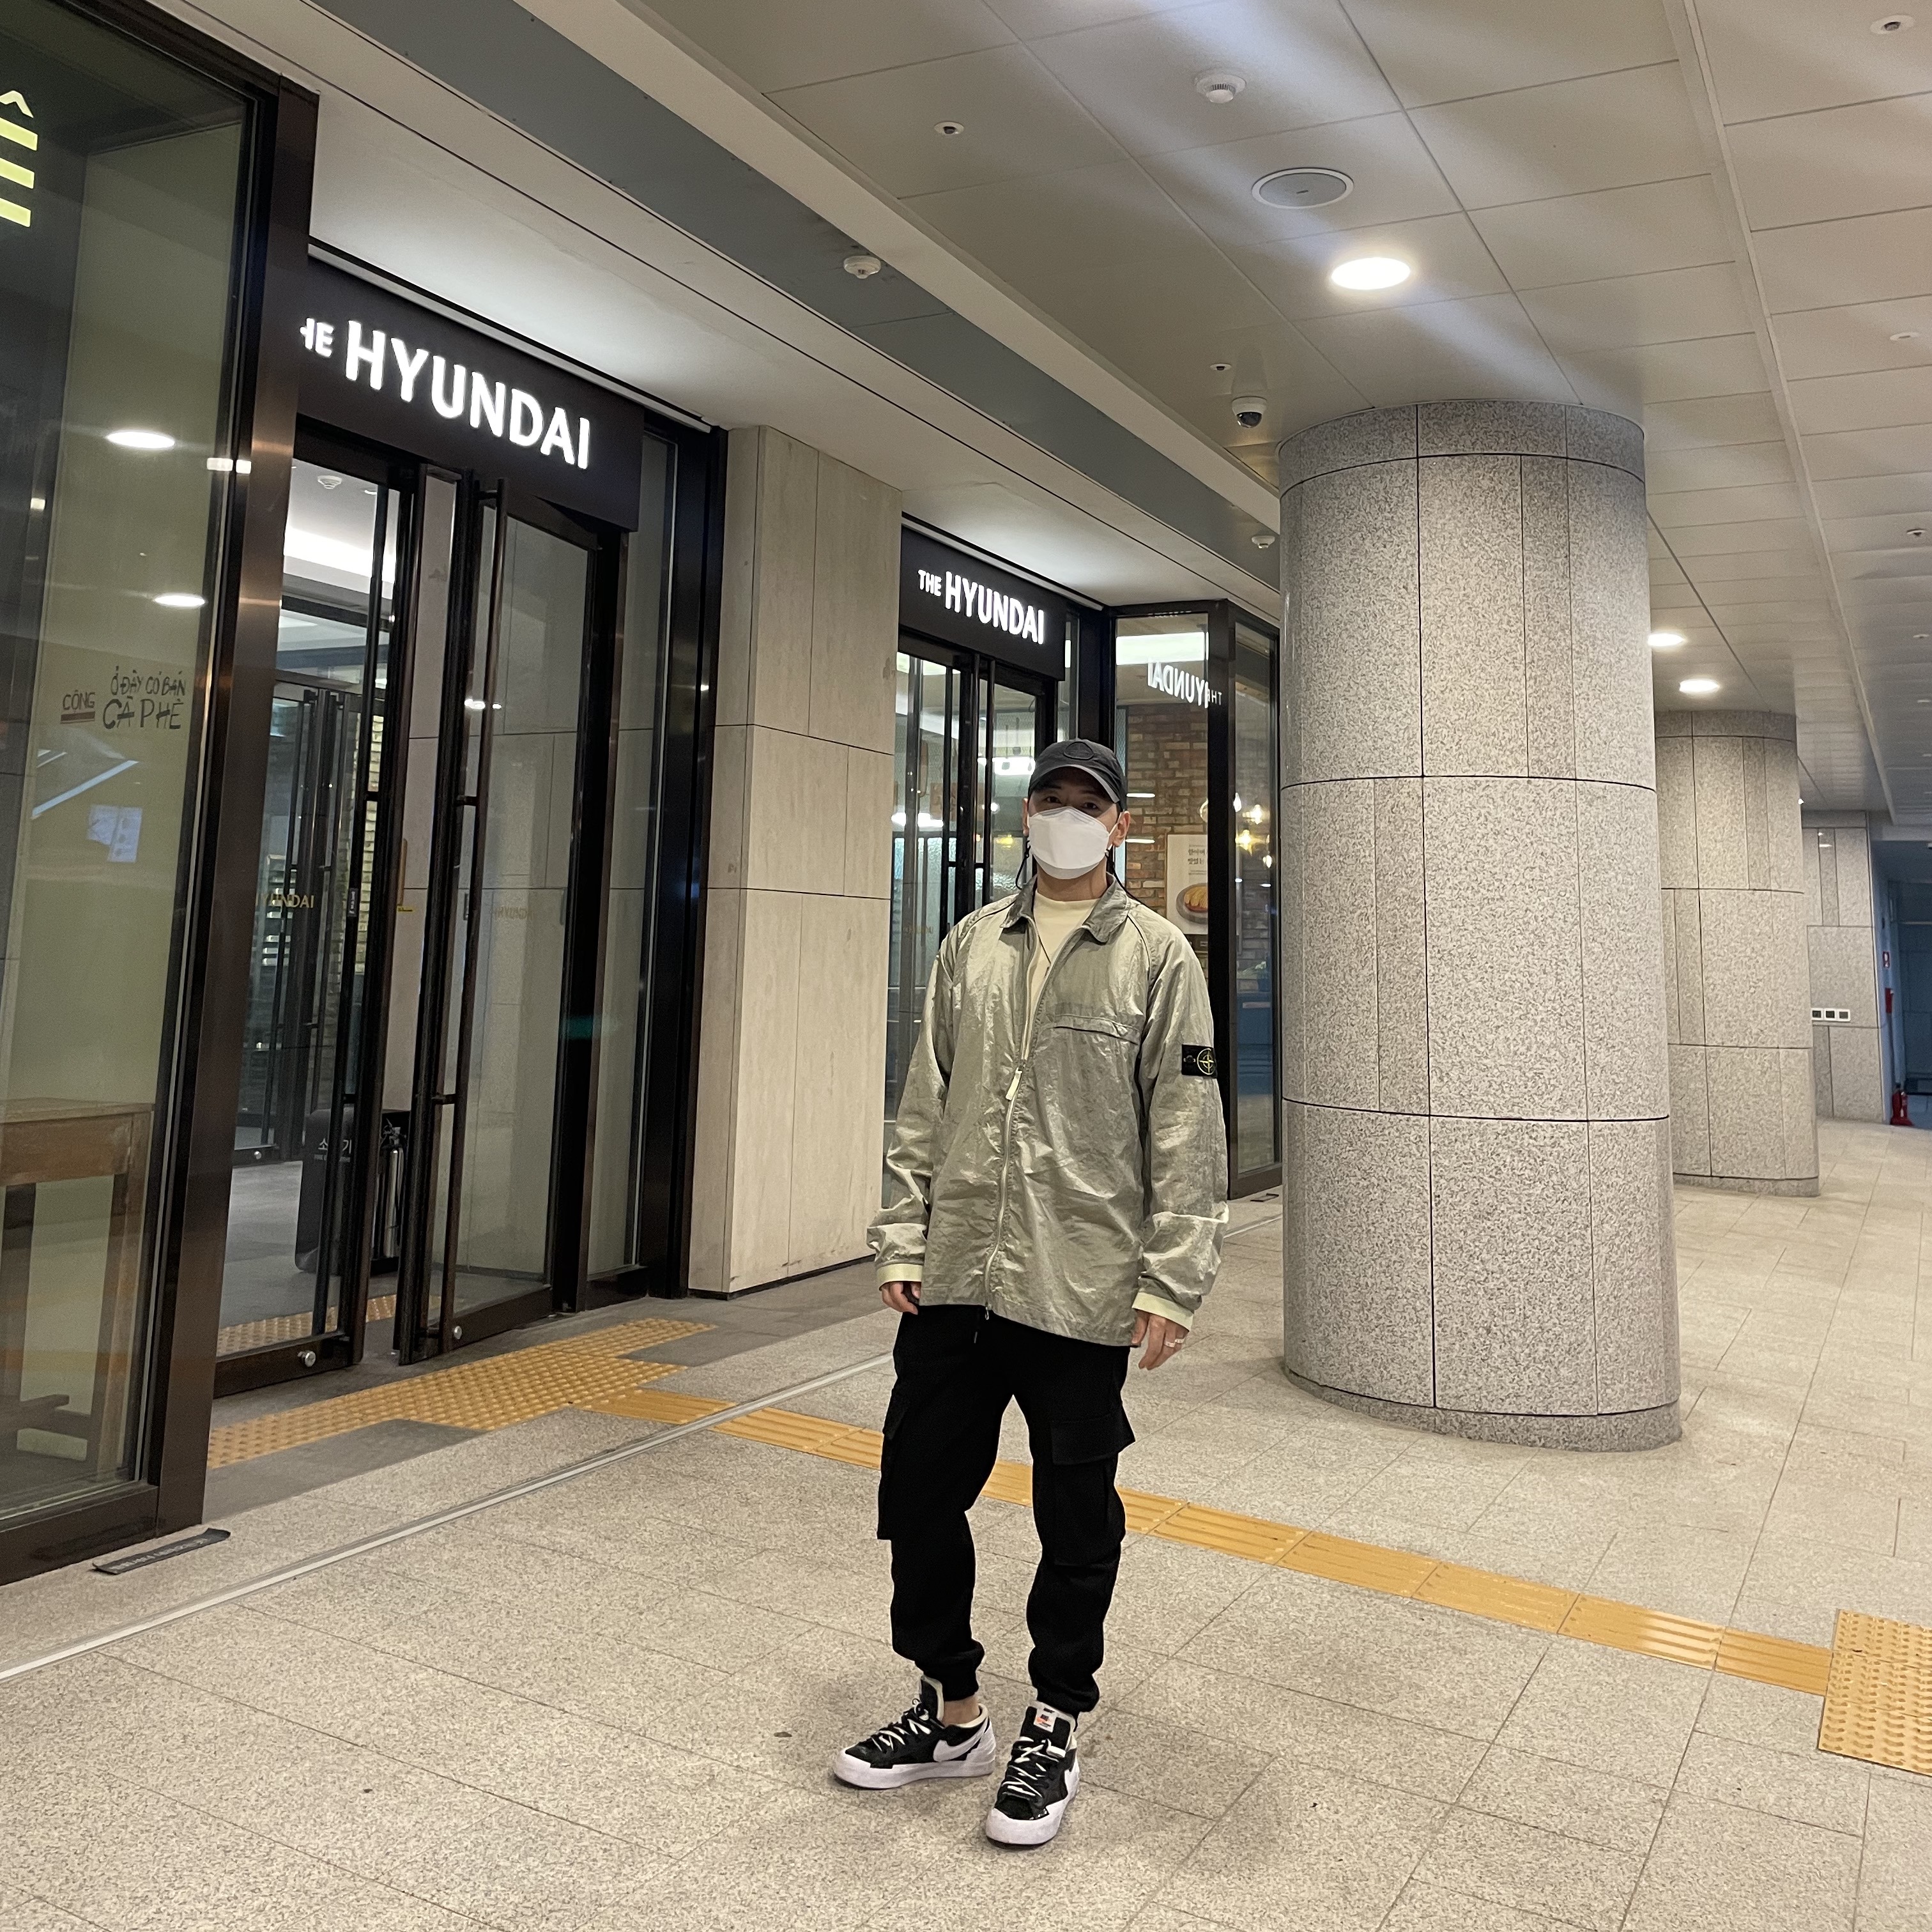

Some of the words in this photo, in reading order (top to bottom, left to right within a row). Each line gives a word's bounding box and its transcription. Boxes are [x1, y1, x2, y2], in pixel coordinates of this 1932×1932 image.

[300, 318, 335, 358] HE
[346, 320, 590, 470] HYUNDAI
[918, 569, 942, 597] THE
[945, 571, 1044, 645] HYUNDAI
[318, 1137, 352, 1154] 소기
